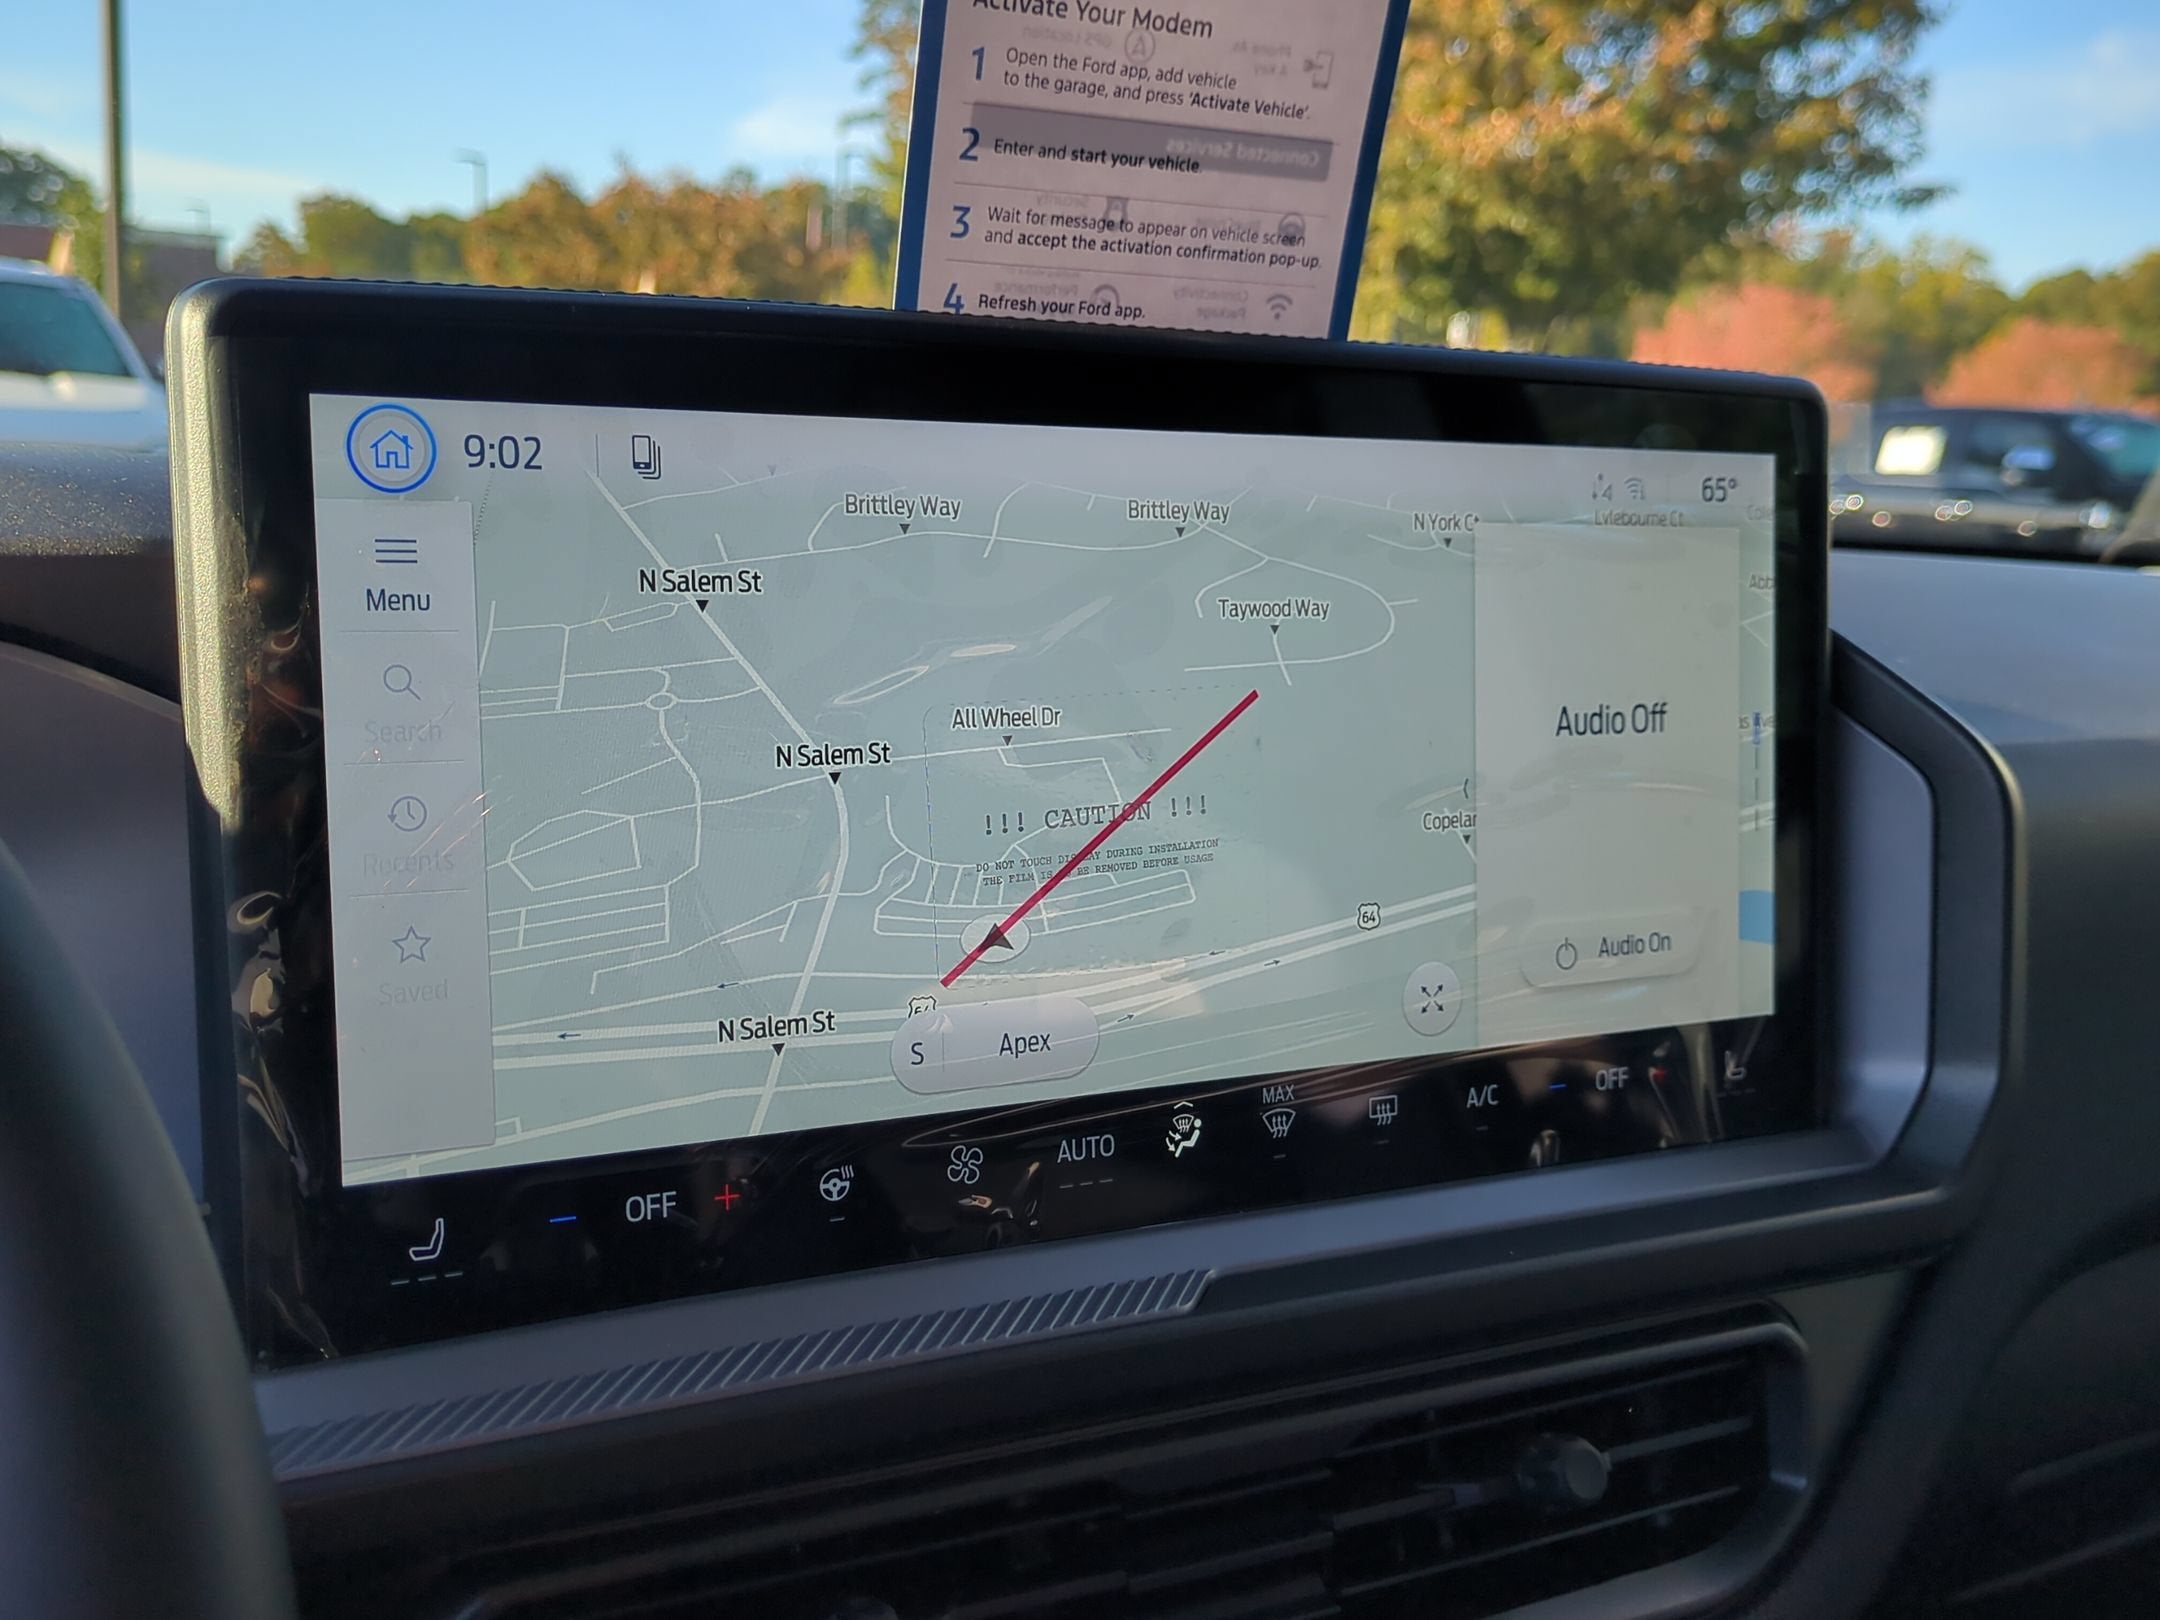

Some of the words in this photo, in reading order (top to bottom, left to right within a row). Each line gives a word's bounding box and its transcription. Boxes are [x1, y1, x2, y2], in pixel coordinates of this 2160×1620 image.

[1076, 1, 1126, 26] Your
[1132, 8, 1213, 38] Modem
[972, 46, 985, 81] 1
[1006, 48, 1047, 67] Open
[1053, 53, 1077, 71] the
[1082, 57, 1116, 75] Ford
[1120, 64, 1150, 82] app,
[1155, 68, 1183, 84] add
[1188, 72, 1237, 90] vehicle
[1004, 71, 1019, 87] to
[1024, 73, 1049, 89] the
[1054, 78, 1108, 98] garage,
[1113, 85, 1140, 100] and
[1145, 90, 1184, 105] press
[959, 127, 980, 161] 2
[994, 139, 1034, 156] Enter
[1038, 144, 1066, 160] and
[1071, 149, 1107, 164] start
[1111, 153, 1144, 169] your
[950, 205, 971, 239] 3
[988, 206, 1021, 224] Wait
[1026, 209, 1046, 225] for
[1050, 214, 1114, 233] message
[1119, 218, 1134, 233] to
[1138, 222, 1186, 238] appear
[1190, 226, 1207, 239] on
[1212, 227, 1258, 244] vehicle
[1263, 231, 1305, 247] screen
[984, 229, 1013, 244] and
[1017, 232, 1067, 250] accept
[1072, 235, 1096, 250] the
[1100, 238, 1172, 256] activation
[1176, 244, 1265, 264] confirmation
[943, 282, 965, 315] 4
[978, 293, 1036, 312] Refresh
[1041, 300, 1075, 317] your
[1078, 301, 1111, 316] Ford
[1115, 305, 1145, 321] app.
[463, 434, 543, 470] 9:02
[844, 495, 917, 519] Brittley
[921, 496, 961, 520] Way
[1127, 500, 1189, 523] Brittley
[1191, 502, 1230, 524] Way
[1414, 512, 1425, 531] N
[1428, 512, 1461, 531] York
[1464, 513, 1480, 532] C
[639, 569, 657, 593] N
[662, 569, 733, 594] Salem
[737, 569, 763, 593] St
[365, 588, 431, 612] Menu
[1218, 599, 1291, 621] Taywood
[1295, 600, 1330, 621] Way
[364, 718, 443, 745] Search
[952, 707, 976, 730] All
[980, 706, 1037, 729] Wheel
[1040, 706, 1061, 728] Dr
[1556, 704, 1626, 737] Audio
[1631, 702, 1668, 734] Off
[775, 745, 793, 769] N
[797, 742, 864, 767] Salem
[868, 742, 891, 765] St
[1045, 800, 1152, 829] CAUTION
[976, 862, 989, 873] DO
[995, 860, 1014, 871] NOT
[1020, 856, 1052, 868] TOUCH
[1058, 850, 1101, 865] DIAY
[1106, 847, 1143, 859] DURING
[1148, 838, 1219, 855] INSTALLATION
[983, 875, 1003, 887] THE
[1008, 872, 1035, 883] FILM
[1041, 870, 1053, 880] IS
[1077, 866, 1090, 876] BE
[1095, 861, 1138, 873] REMOVED
[1143, 857, 1179, 869] BEFORE
[1184, 853, 1214, 864] USAGE
[1362, 910, 1376, 925] 64
[1598, 936, 1645, 958] Audio
[1649, 933, 1672, 953] On
[379, 978, 448, 1006] Saved
[717, 1020, 734, 1043] N
[738, 1015, 808, 1040] Salem
[812, 1011, 836, 1034] St
[910, 1042, 925, 1066] S
[999, 1032, 1051, 1059] Apex
[1595, 1067, 1628, 1091] OFF
[1262, 1084, 1295, 1104] MAX
[1466, 1084, 1499, 1108] A/C
[1057, 1134, 1115, 1163] AUTO
[626, 1190, 677, 1223] OFF
